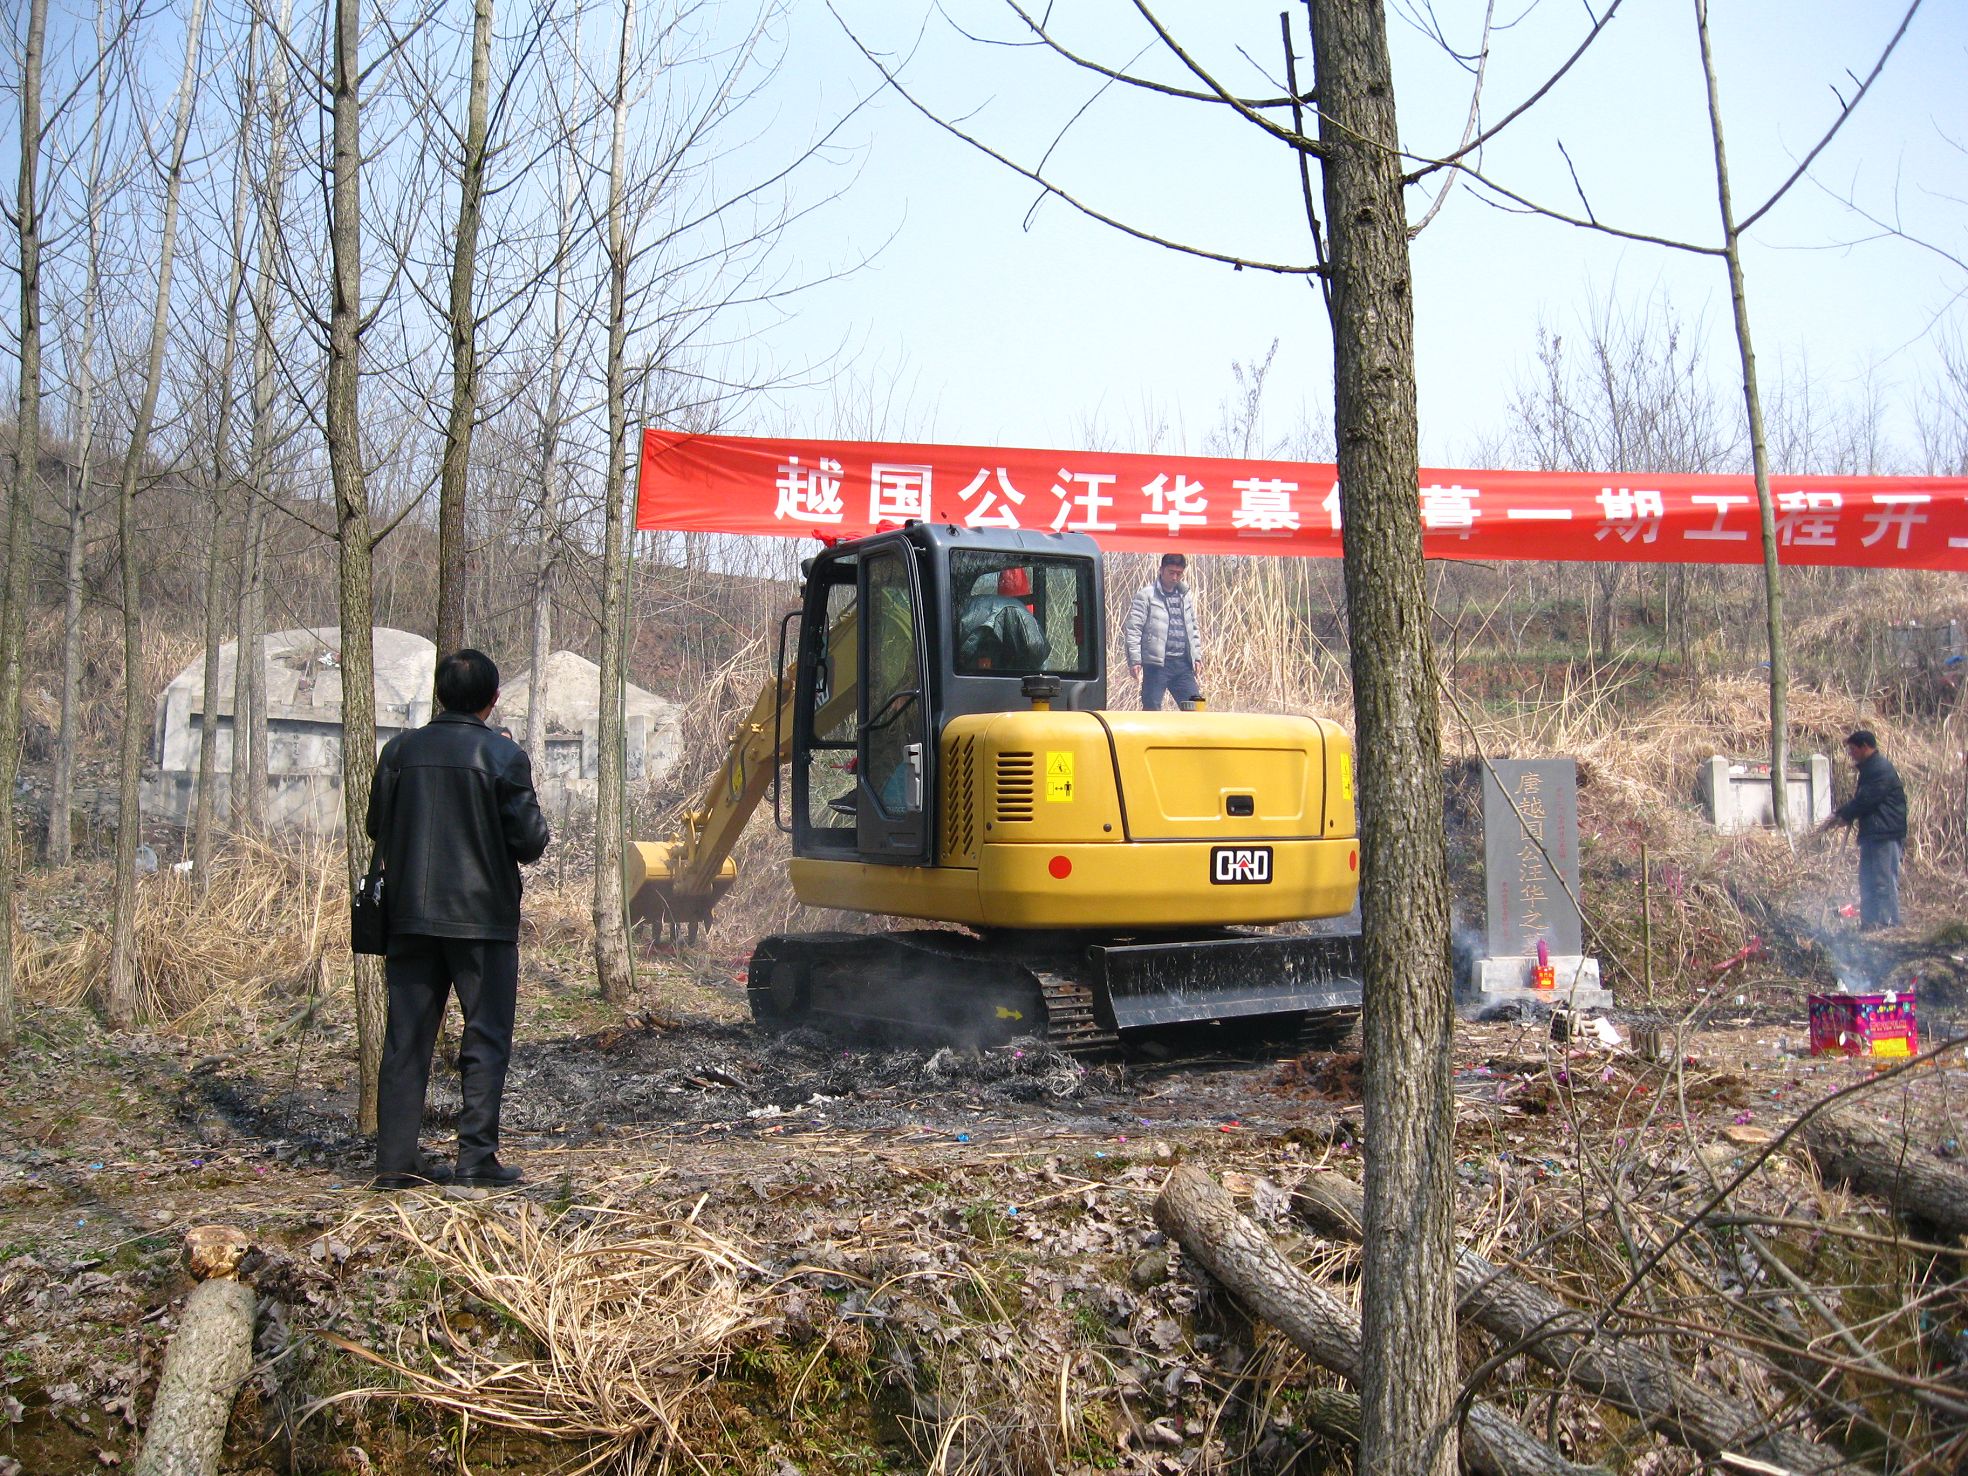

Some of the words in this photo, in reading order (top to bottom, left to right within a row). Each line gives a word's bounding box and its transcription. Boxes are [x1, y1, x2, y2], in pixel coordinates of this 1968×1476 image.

[774, 456, 1968, 549] 越国公汪华墓葺一期工程开
